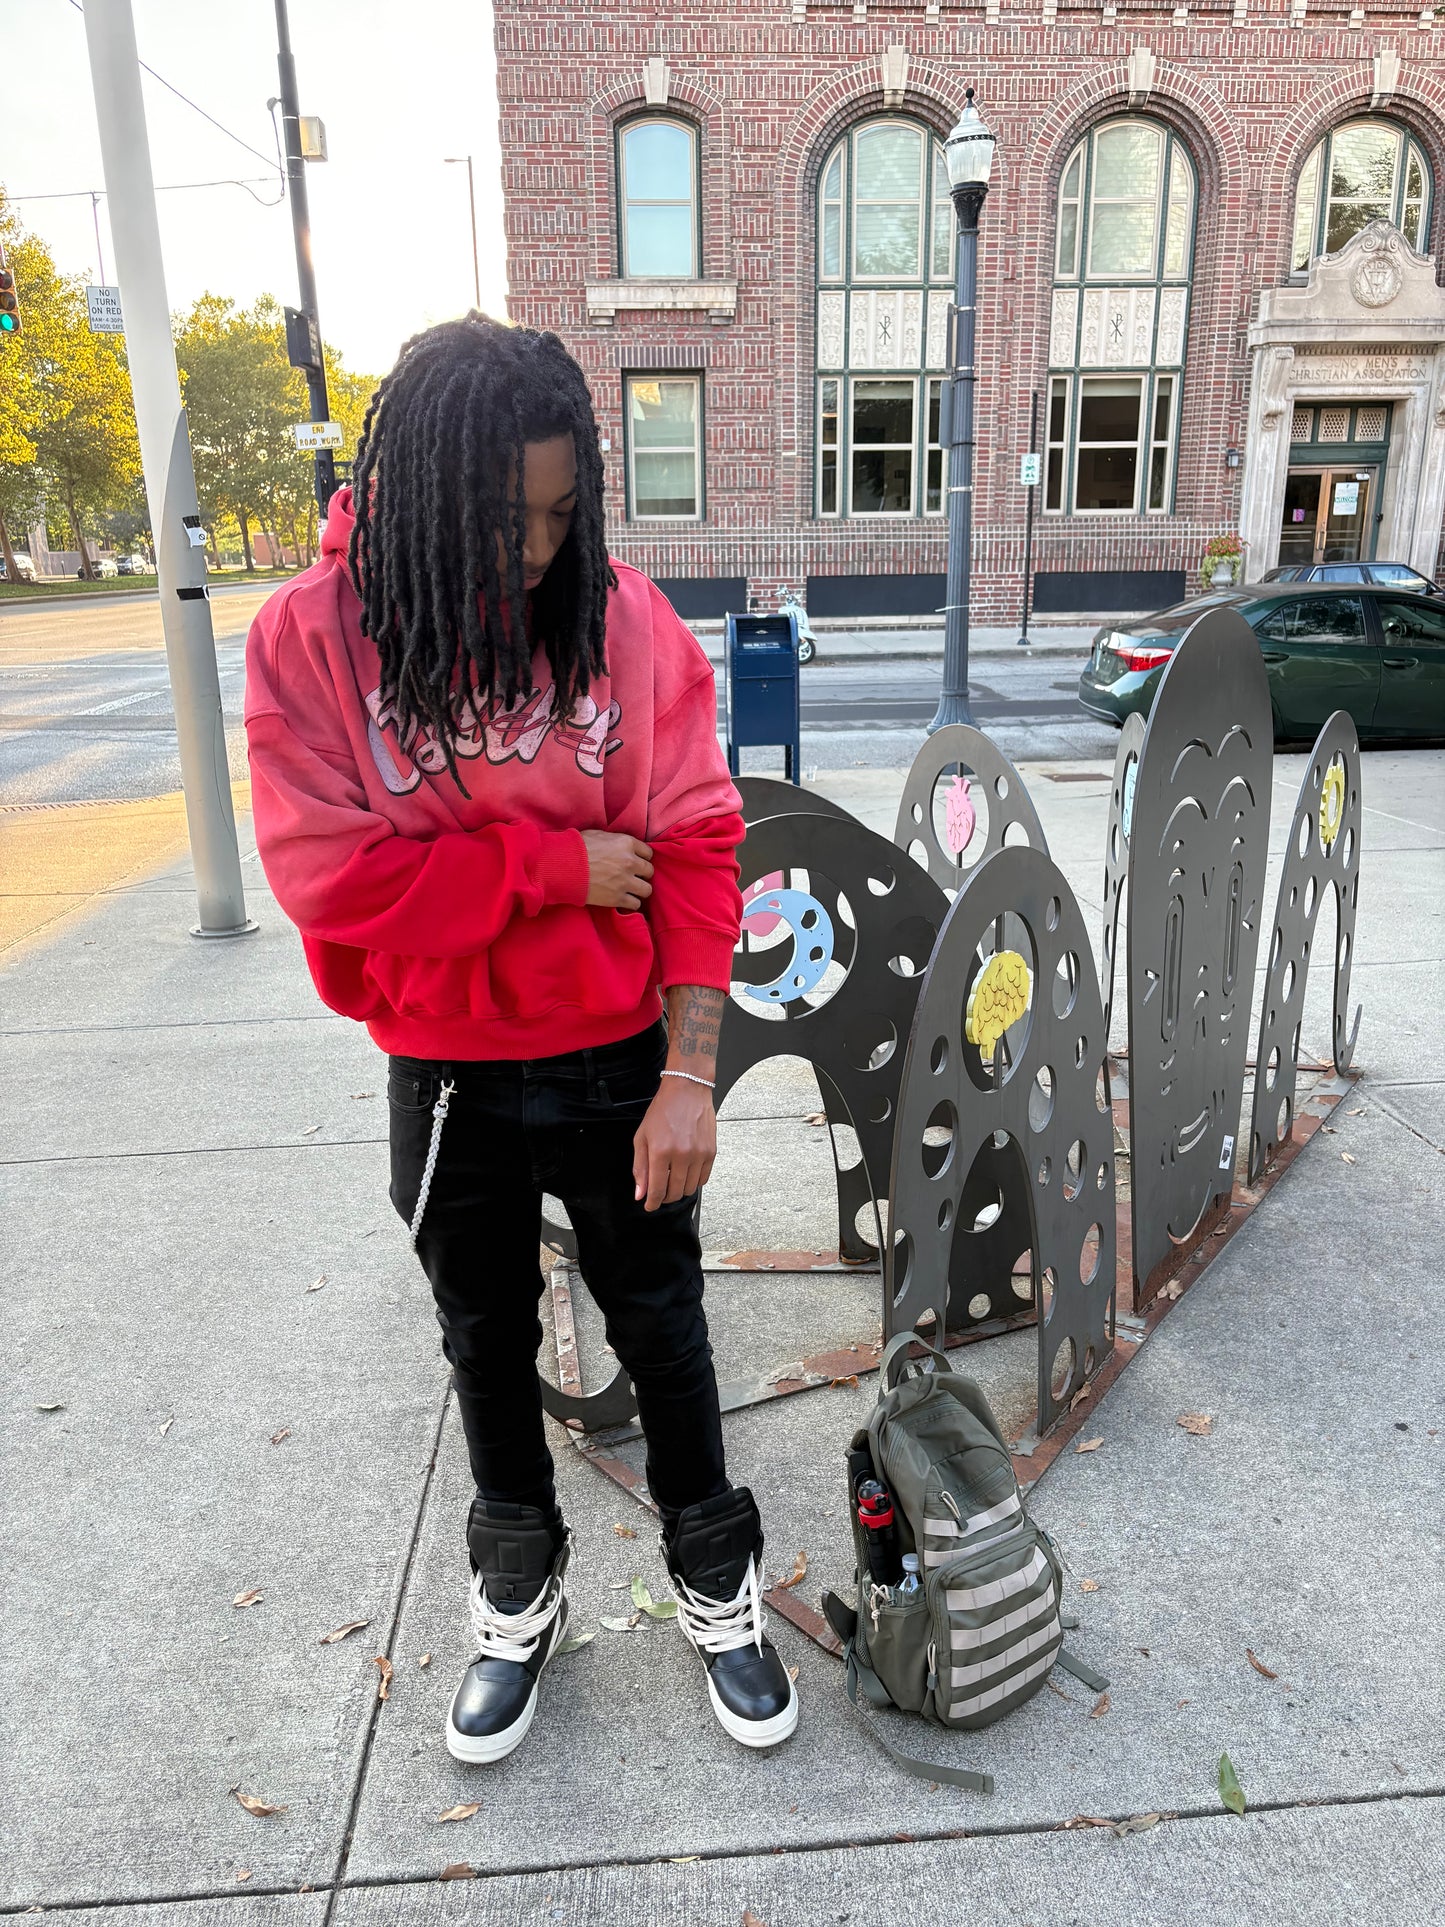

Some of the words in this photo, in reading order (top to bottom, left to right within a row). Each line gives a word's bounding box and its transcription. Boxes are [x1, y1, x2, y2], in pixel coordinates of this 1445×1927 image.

[95, 298, 116, 306] TURN
[106, 307, 122, 315] RED
[1321, 358, 1359, 369] YOUNG
[1365, 357, 1399, 368] MEN'S
[1288, 368, 1349, 380] CHRISTIAN
[1353, 367, 1427, 380] ASSOCIATION
[312, 426, 325, 434] END
[299, 438, 318, 446] ROAD
[320, 436, 340, 445] WORK
